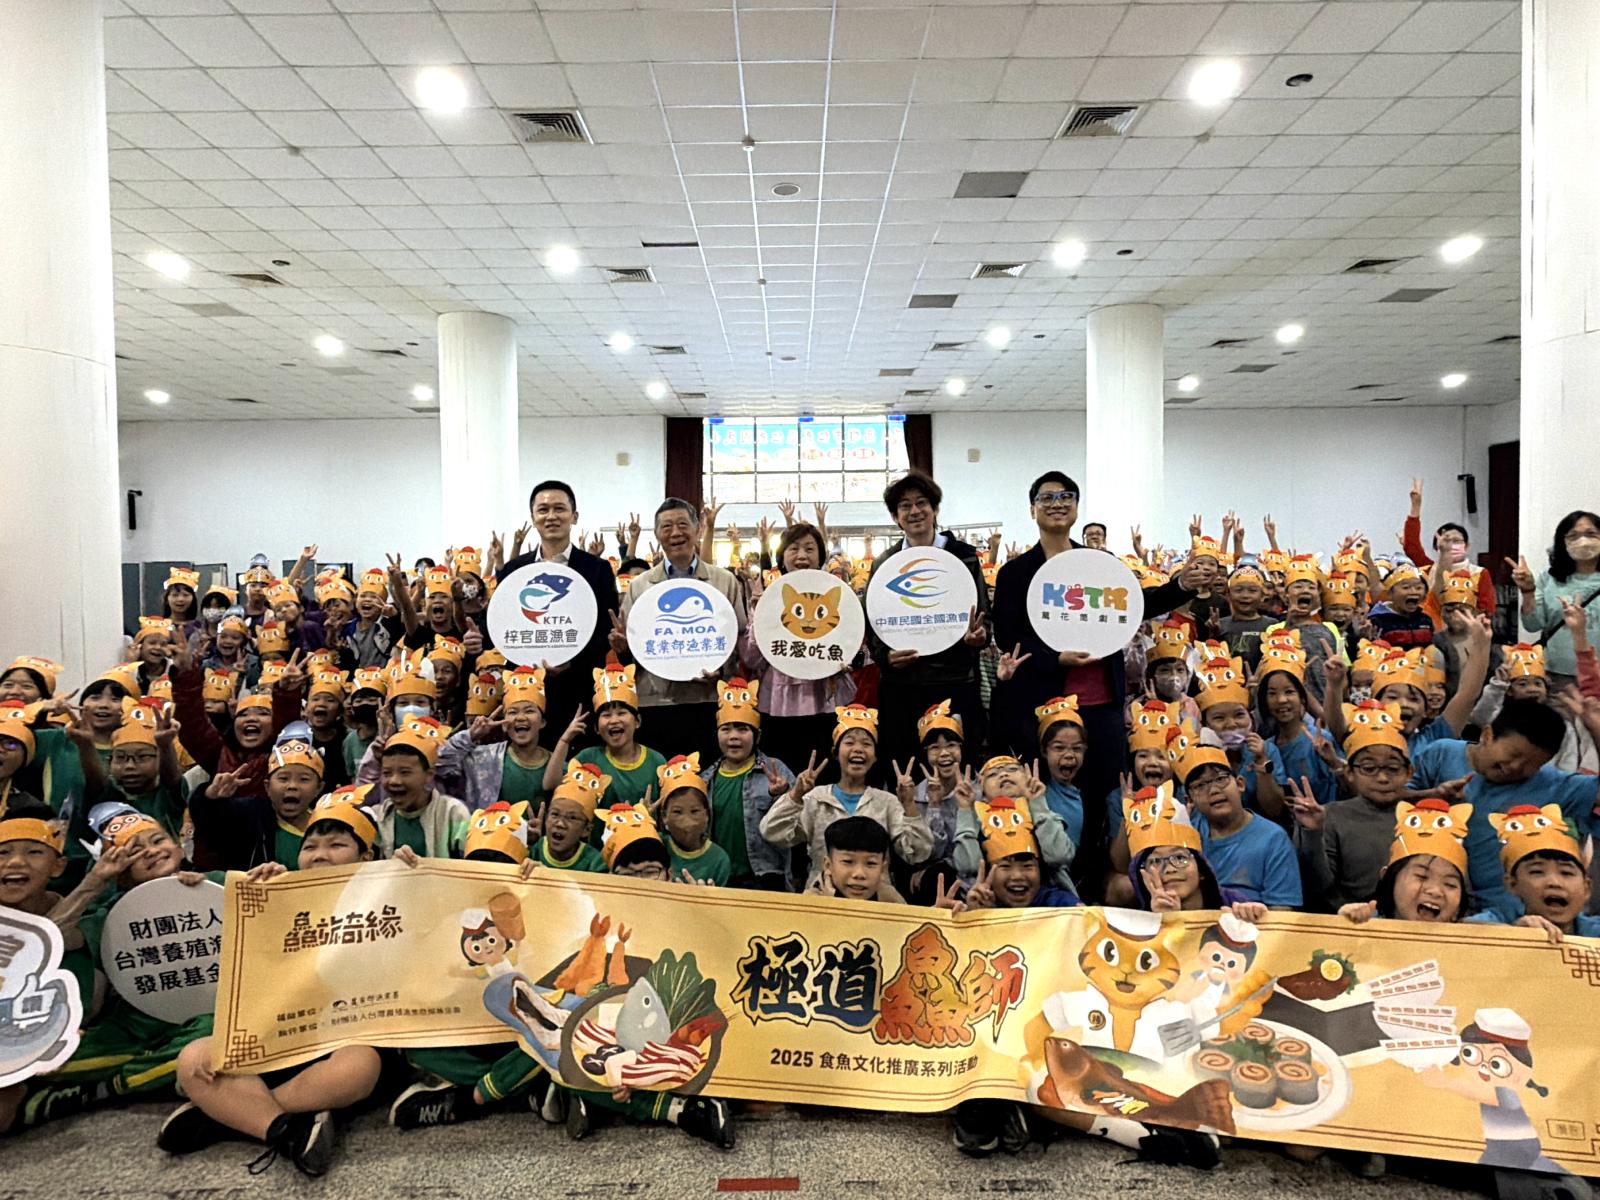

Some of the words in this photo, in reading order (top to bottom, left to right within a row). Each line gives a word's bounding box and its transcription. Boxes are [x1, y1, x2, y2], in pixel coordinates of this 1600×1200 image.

[1042, 582, 1129, 611] KSTR
[543, 615, 573, 625] KTFA
[654, 627, 674, 636] FA
[681, 625, 717, 635] MOA
[875, 612, 969, 626] 中華民國全國漁會
[503, 628, 579, 644] 梓官區漁會
[770, 639, 844, 662] 我愛吃魚
[128, 907, 223, 942] 財團法人
[133, 962, 220, 995] 發展基金
[730, 922, 1027, 1048] 極道鱻師
[770, 1047, 815, 1068] 2025
[819, 1051, 980, 1077] 食魚文化推廣系列活動
